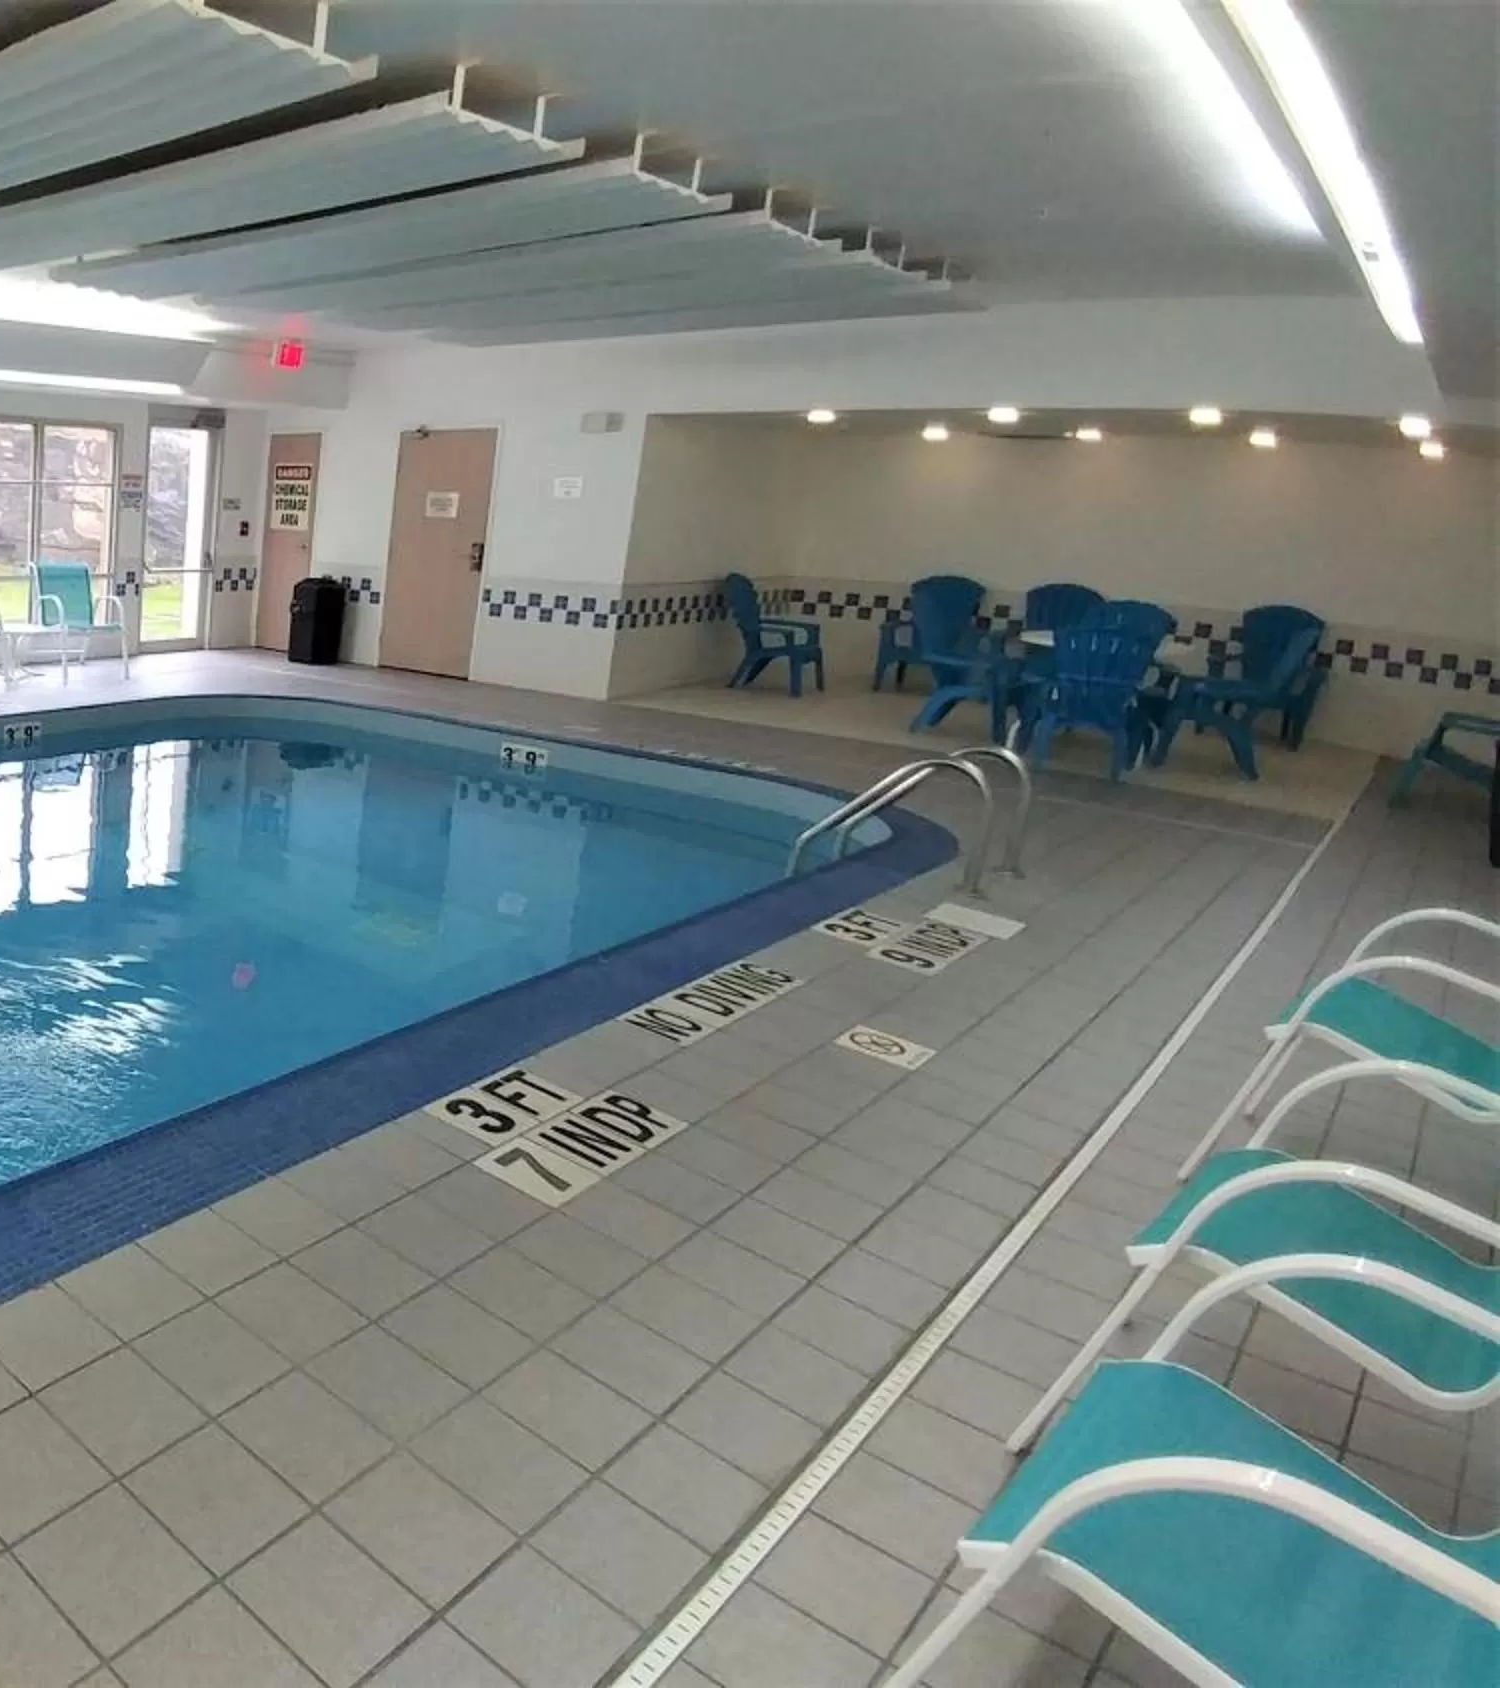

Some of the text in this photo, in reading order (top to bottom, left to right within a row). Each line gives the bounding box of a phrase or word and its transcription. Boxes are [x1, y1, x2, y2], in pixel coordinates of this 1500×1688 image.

[275, 484, 308, 496] CHEMICAL
[275, 499, 307, 511] STORAGE
[280, 514, 299, 526] AREA
[625, 963, 793, 1042] NO DIVING
[493, 1147, 572, 1193] 7
